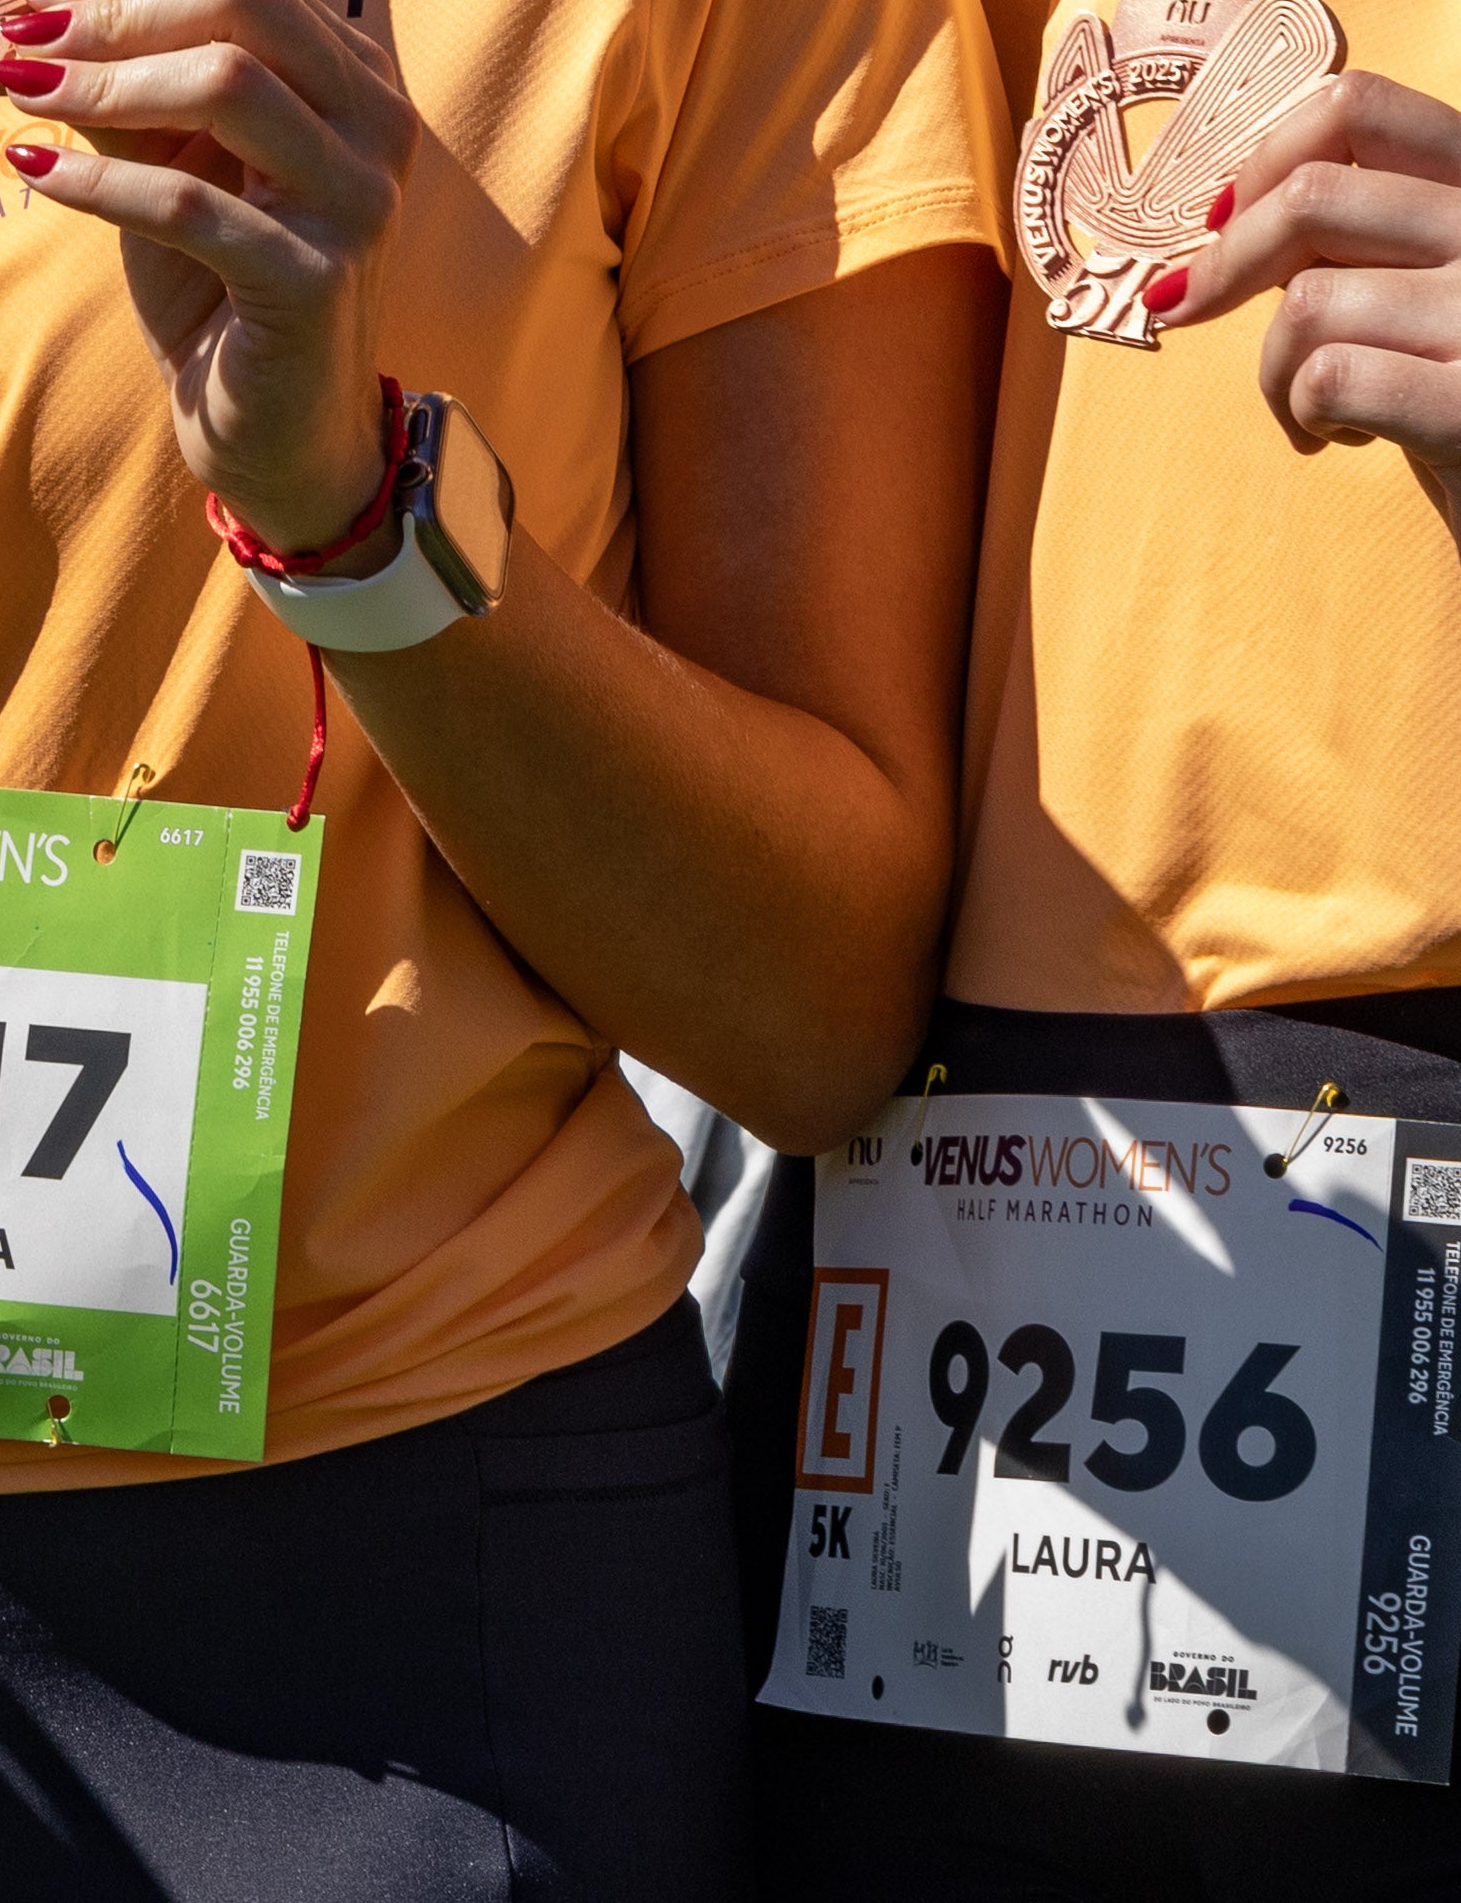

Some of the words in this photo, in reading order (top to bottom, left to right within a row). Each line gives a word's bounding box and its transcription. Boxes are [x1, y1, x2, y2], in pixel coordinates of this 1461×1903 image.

[1128, 56, 1186, 83] 2025
[159, 827, 205, 847] 6617
[245, 956, 264, 971] 11
[268, 931, 290, 1002] TELEFONE
[241, 974, 262, 1010] 955
[237, 1012, 257, 1051] 006
[266, 1006, 281, 1024] DE
[232, 1054, 253, 1091] 296
[255, 1028, 279, 1121] EMERGÊNCIA
[1322, 1136, 1369, 1157] 9256
[957, 1199, 997, 1222] HALF
[1005, 1199, 1155, 1228] MARATHON
[1416, 1267, 1436, 1283] 11
[1441, 1240, 1461, 1315] TELEFONE
[186, 1279, 223, 1354] 6617
[218, 1217, 252, 1415] GUARDA-VOLUME
[1414, 1287, 1435, 1323] 955
[46, 1336, 61, 1346] DO
[1410, 1326, 1433, 1365] 006
[1439, 1317, 1456, 1338] DE
[820, 1302, 864, 1459] E
[1408, 1367, 1430, 1404] 296
[1433, 1340, 1455, 1437] EMERGÊNCIA
[928, 1319, 1318, 1503] 9256
[808, 1503, 854, 1560] 5K
[1010, 1531, 1158, 1585] LAURA
[1362, 1592, 1402, 1676] 9256
[1394, 1534, 1432, 1738] GUARDA-VOLUME
[1173, 1650, 1217, 1662] GOVERNO
[1221, 1654, 1235, 1663] DO
[1148, 1660, 1258, 1702] BRASIL
